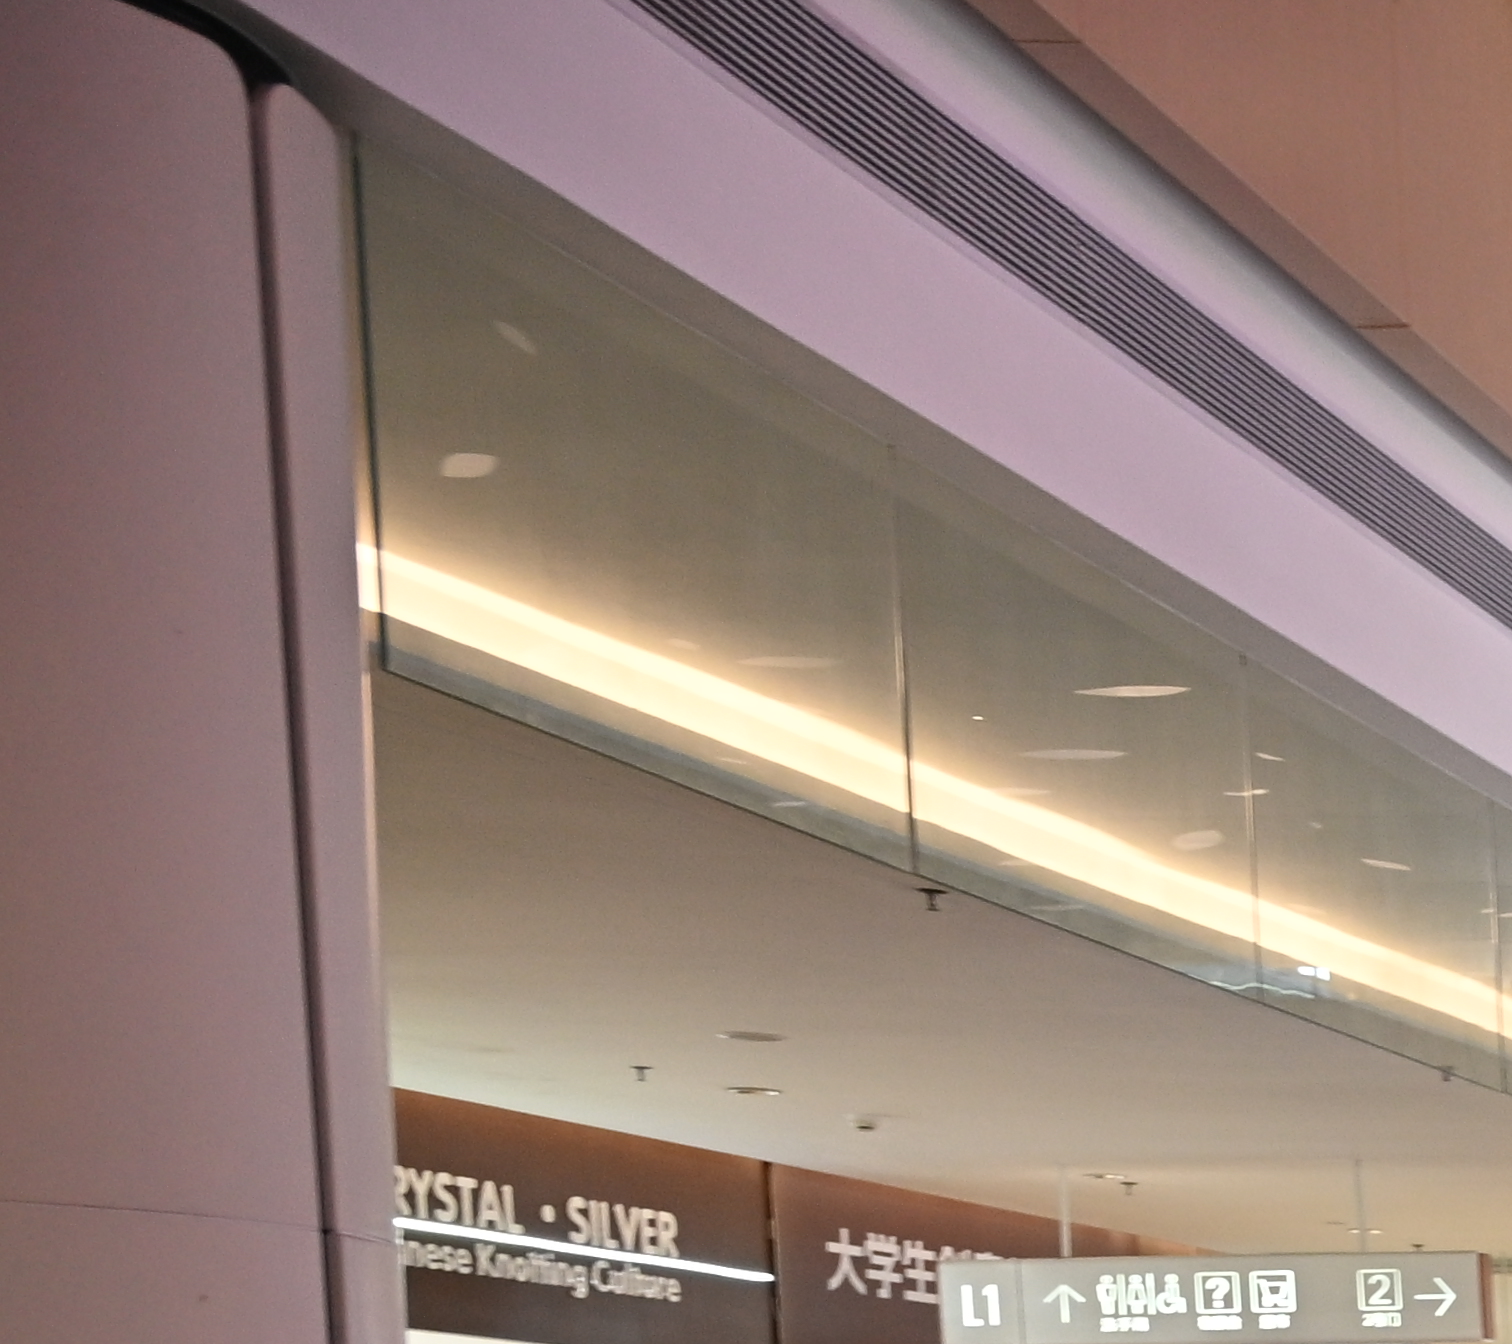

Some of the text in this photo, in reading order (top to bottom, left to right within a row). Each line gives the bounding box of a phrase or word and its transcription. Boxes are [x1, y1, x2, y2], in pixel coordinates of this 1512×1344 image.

[567, 1195, 680, 1258] SILVER
[824, 1227, 1007, 1306] 大学生
[1367, 1274, 1392, 1306] 2
[960, 1283, 1001, 1328] L1
